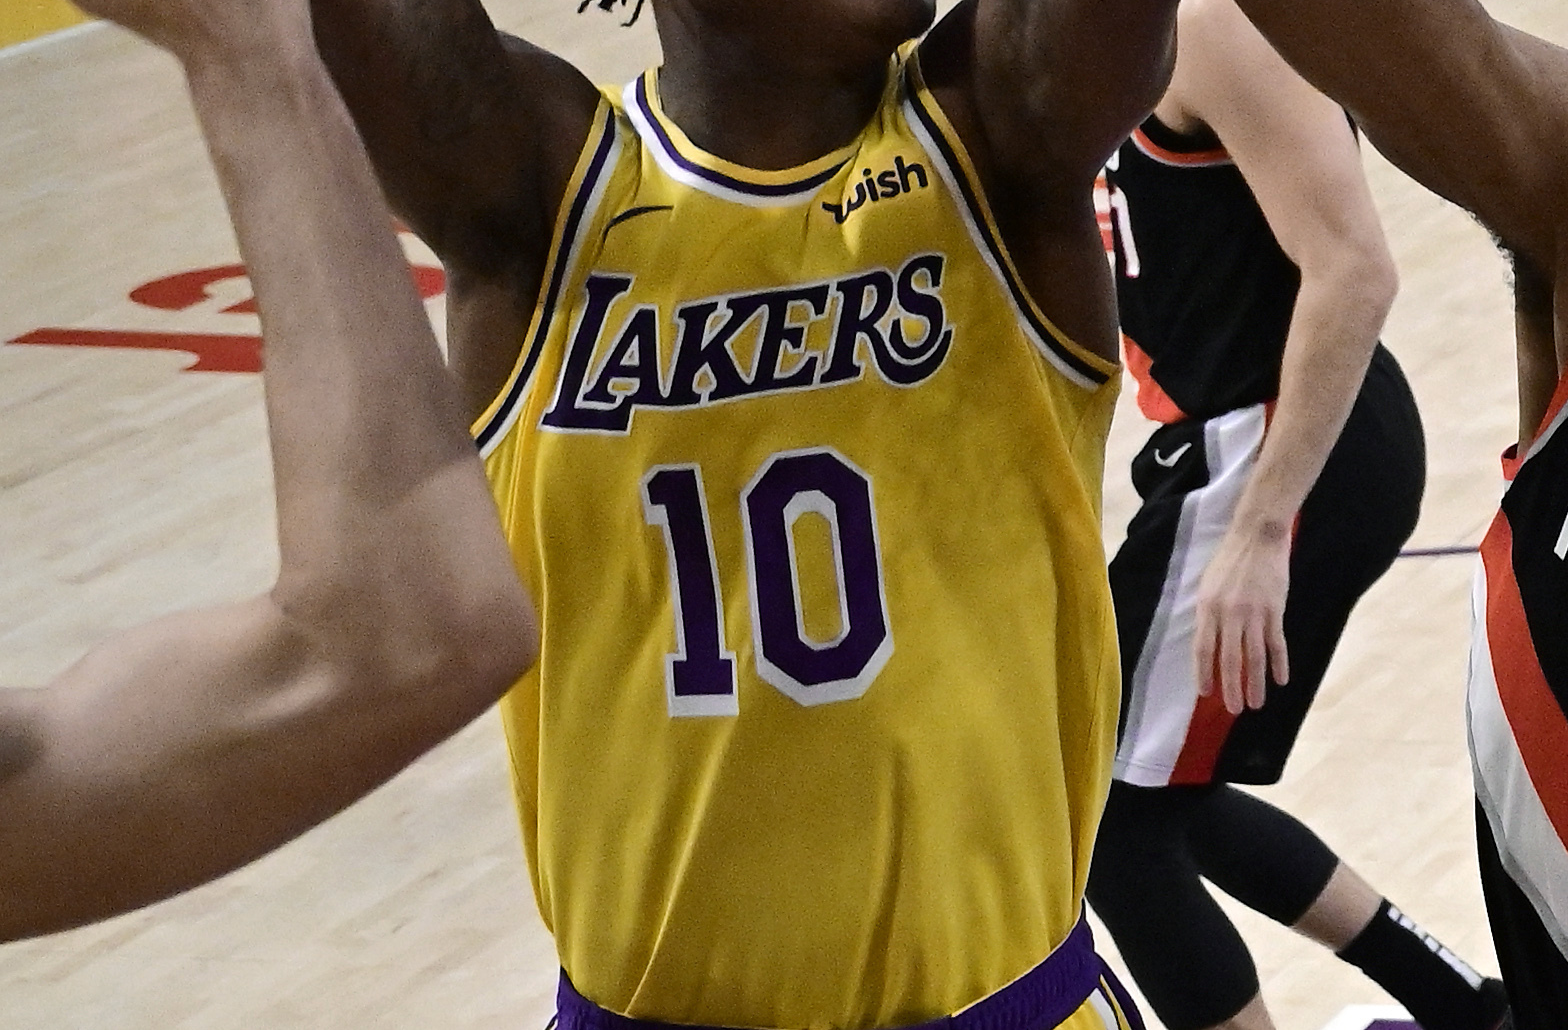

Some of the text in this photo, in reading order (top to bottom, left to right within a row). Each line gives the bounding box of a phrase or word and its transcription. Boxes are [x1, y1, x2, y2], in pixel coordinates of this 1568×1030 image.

[821, 155, 930, 225] wish
[537, 253, 955, 435] LAKERS
[639, 445, 895, 718] 10
